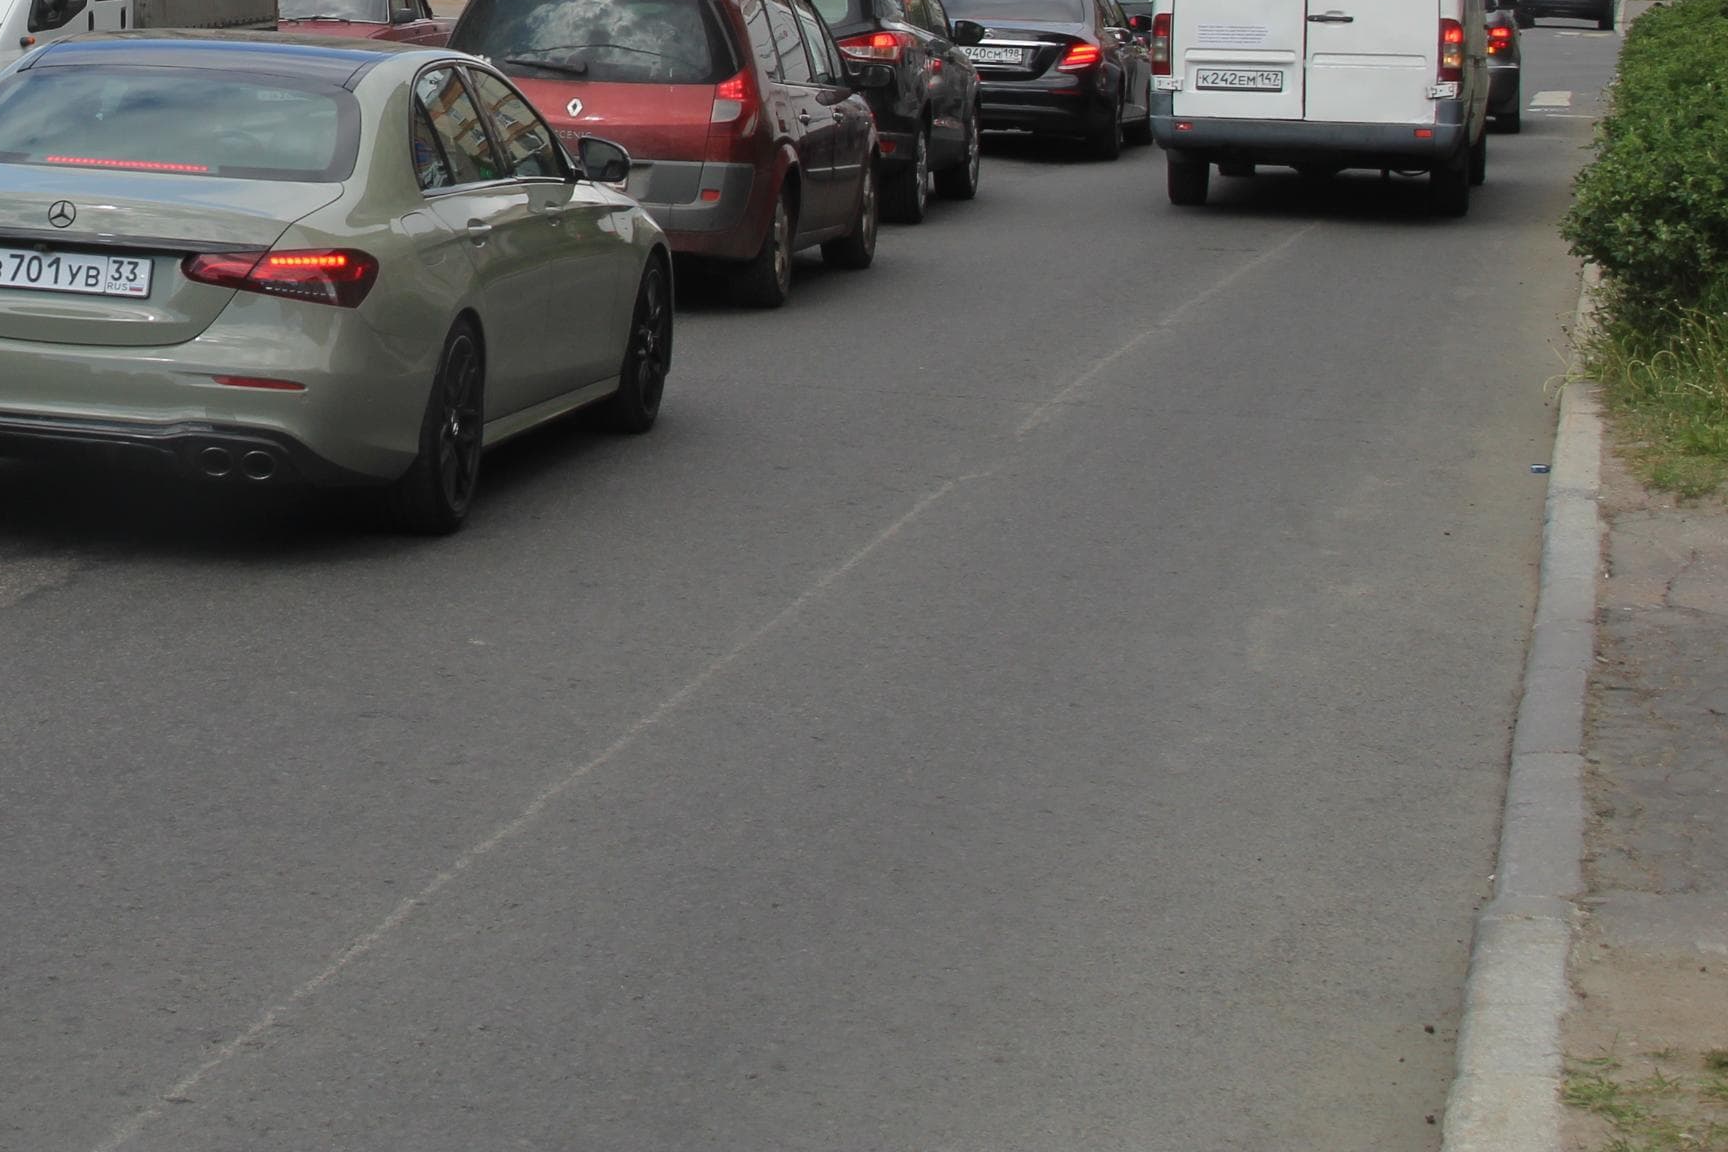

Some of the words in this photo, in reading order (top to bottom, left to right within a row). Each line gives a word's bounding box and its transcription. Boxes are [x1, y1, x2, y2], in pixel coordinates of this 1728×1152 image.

[1003, 48, 1019, 57] 198
[1201, 72, 1256, 86] К242ЕМ
[1258, 73, 1279, 83] 147
[110, 259, 140, 283] 33
[106, 281, 128, 292] RUS
